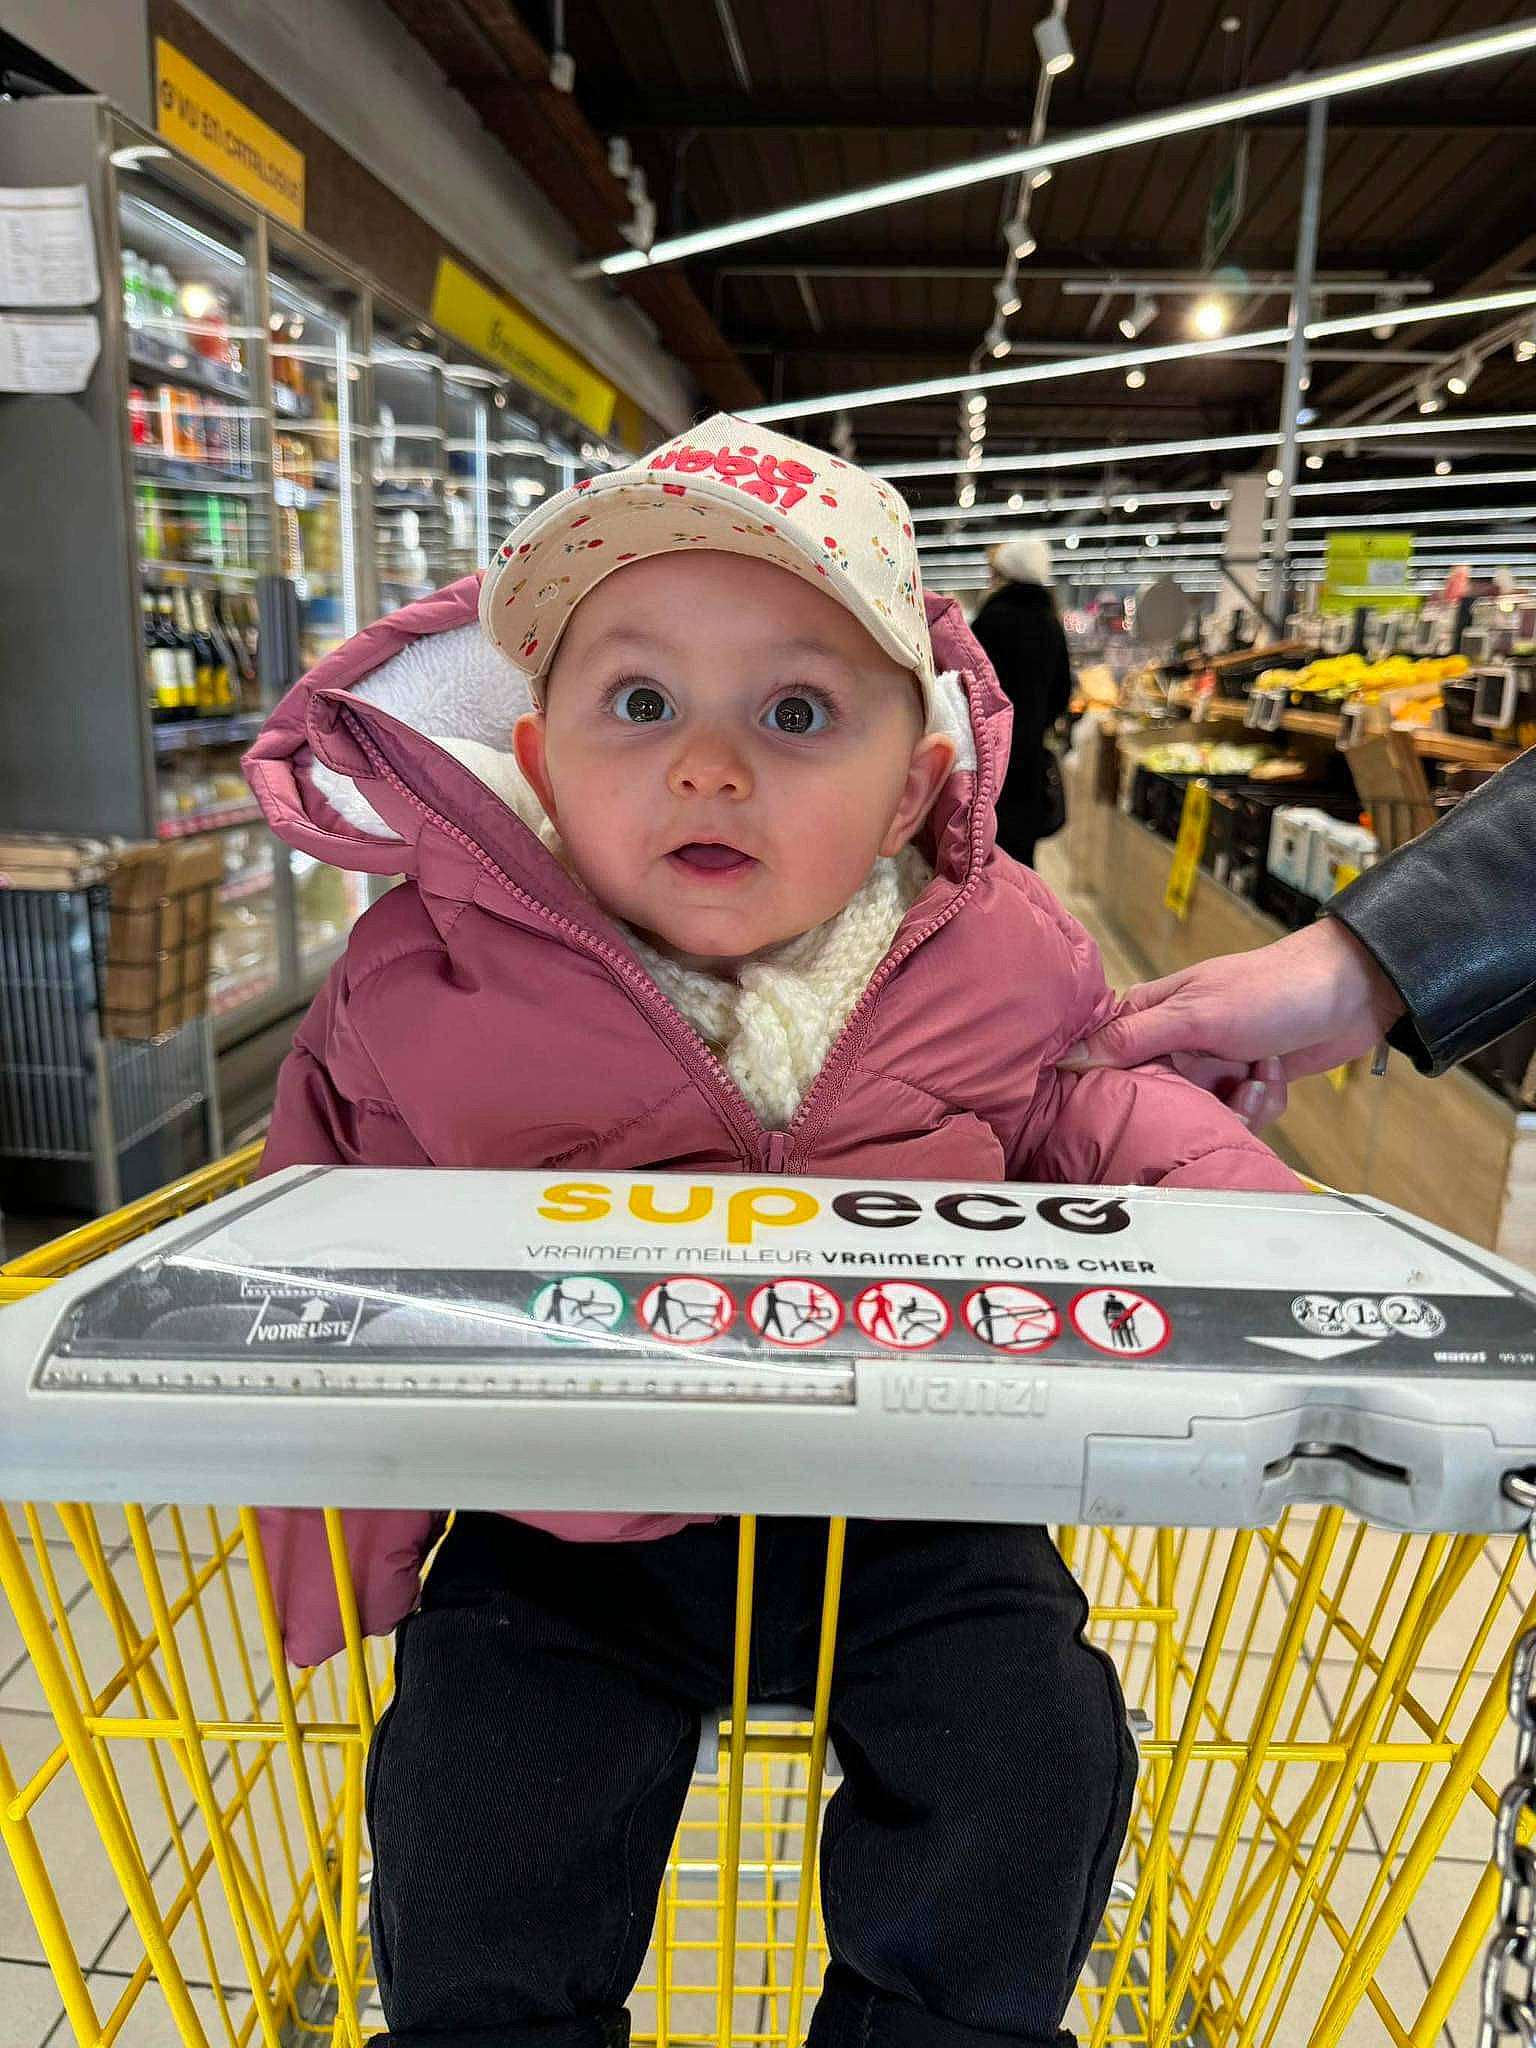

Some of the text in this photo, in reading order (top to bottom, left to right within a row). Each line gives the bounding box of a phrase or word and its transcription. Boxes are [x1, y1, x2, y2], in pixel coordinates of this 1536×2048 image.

[537, 1182, 1130, 1244] supeco
[526, 1244, 1158, 1274] VRAIMENT MEILLEUR VRAIMENT MOINS CHER
[258, 1321, 351, 1342] VOTRE LISTE
